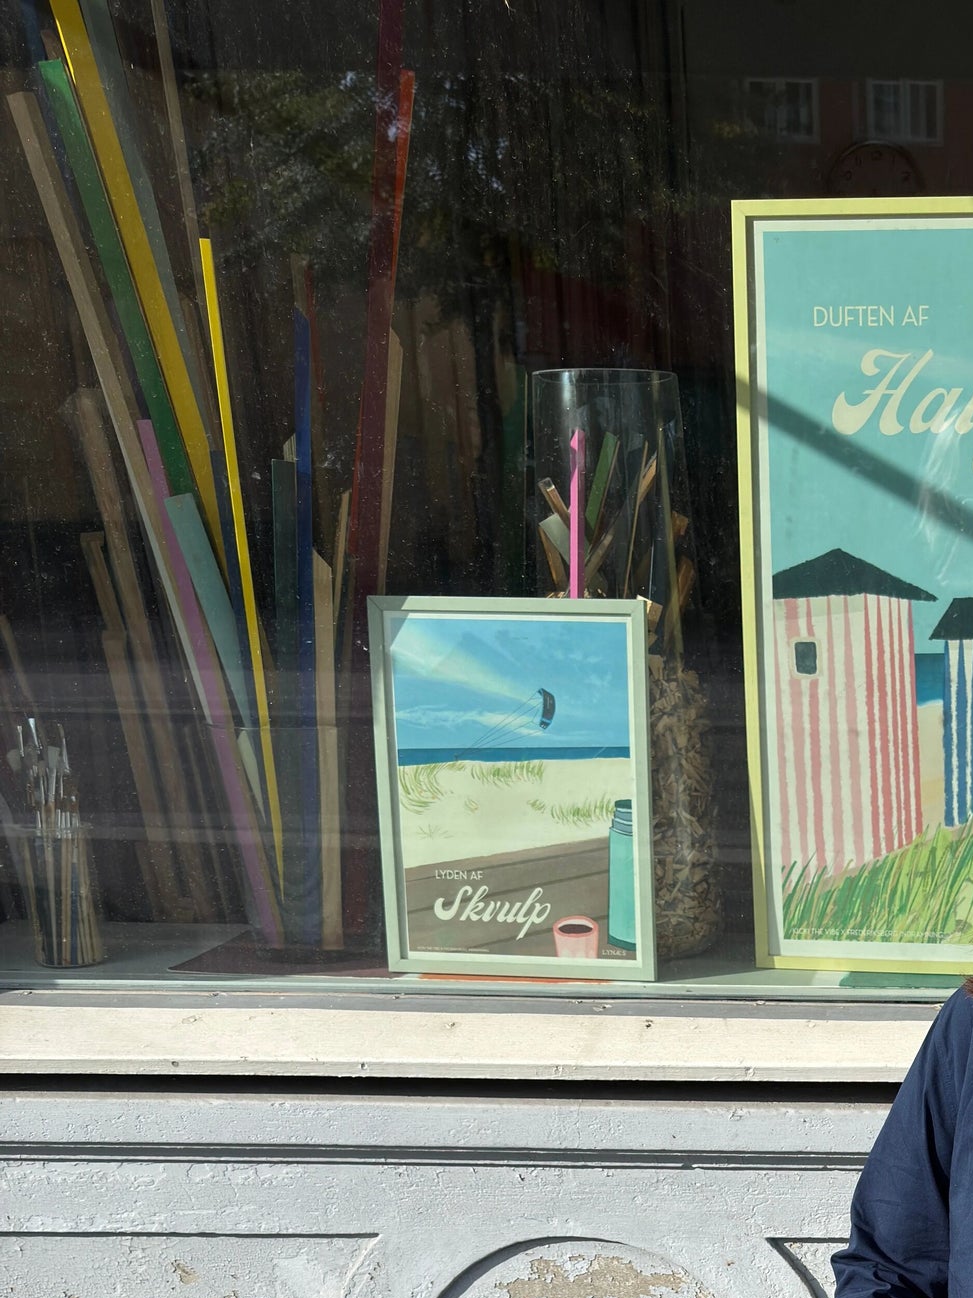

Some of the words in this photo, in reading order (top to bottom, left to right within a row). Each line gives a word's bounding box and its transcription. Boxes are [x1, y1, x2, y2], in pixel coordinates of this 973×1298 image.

[813, 305, 894, 327] DUFTEN
[902, 305, 929, 327] AF
[435, 869, 467, 881] LYDEN
[470, 870, 484, 881] AF
[434, 885, 551, 941] Skvulp
